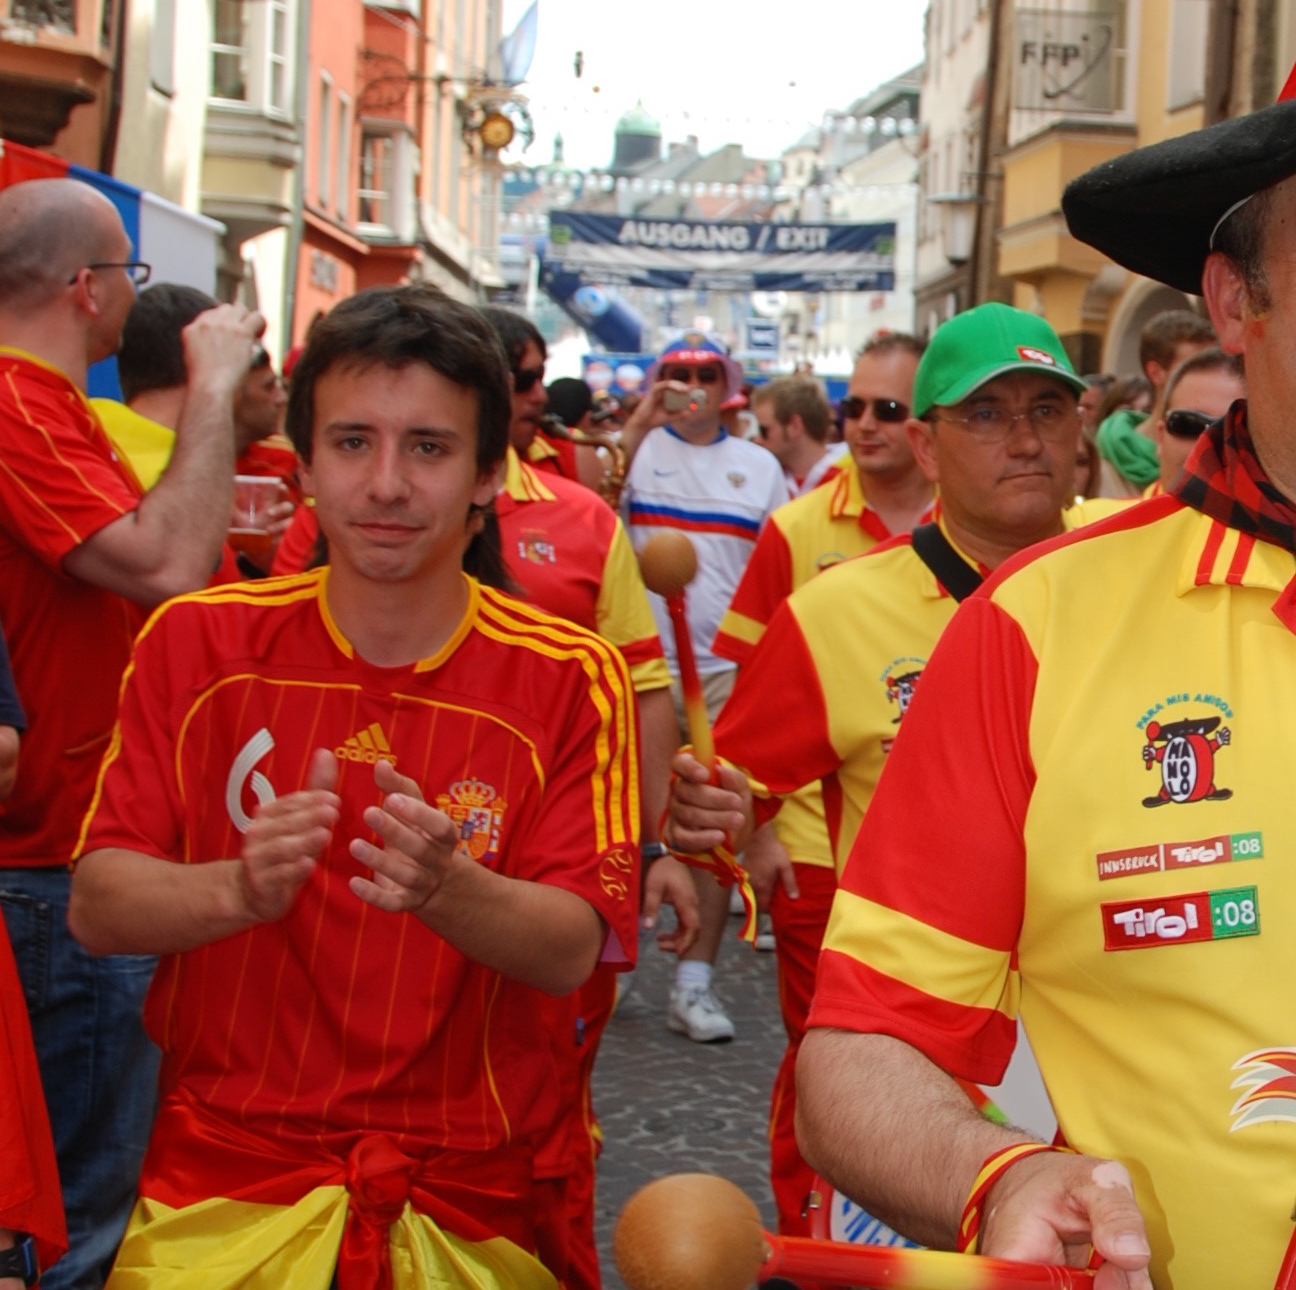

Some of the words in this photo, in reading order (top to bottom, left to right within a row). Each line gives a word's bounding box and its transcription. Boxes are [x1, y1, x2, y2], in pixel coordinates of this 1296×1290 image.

[619, 220, 749, 249] AUSGANG
[756, 226, 772, 249] /
[777, 228, 829, 250] EXIT
[1136, 703, 1164, 729] PARA
[1166, 693, 1190, 706] MIS
[1194, 693, 1234, 718] AMIGOS
[1100, 853, 1159, 876] INNSBRUCK
[1171, 841, 1224, 864] Tirol
[1233, 838, 1260, 856] :08
[1113, 902, 1198, 939] Tirol
[1215, 899, 1256, 927] :08
